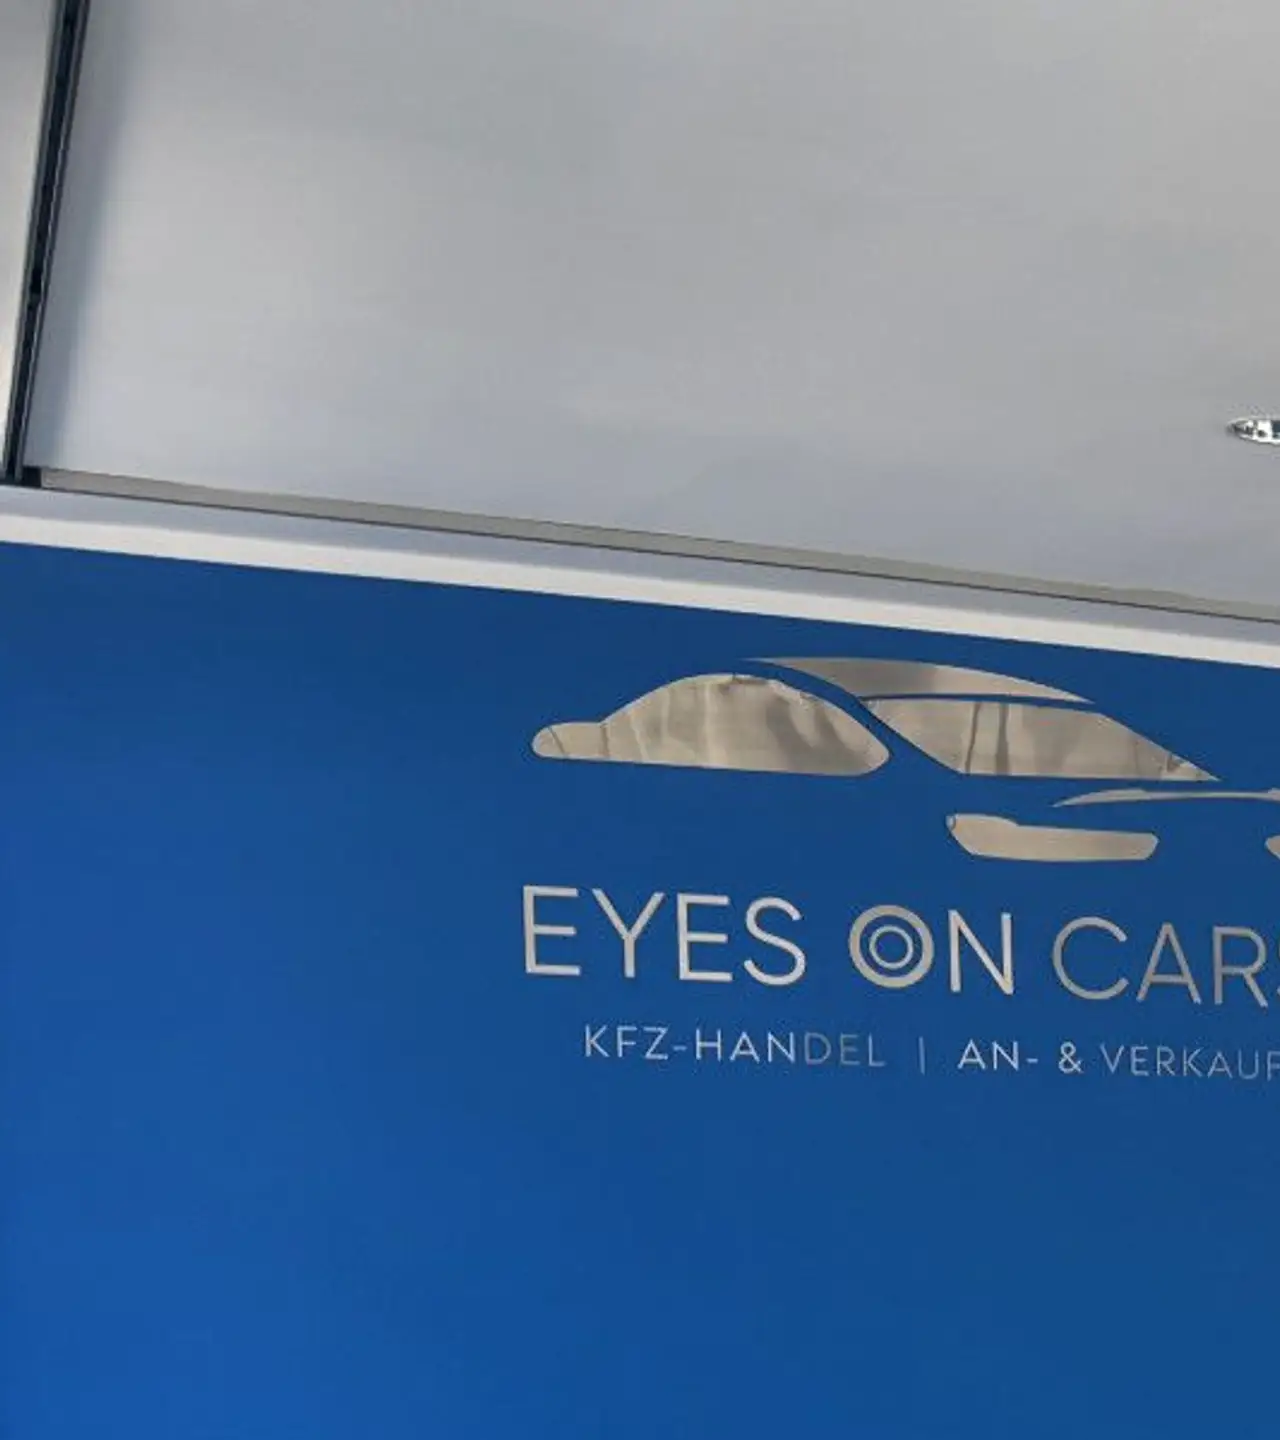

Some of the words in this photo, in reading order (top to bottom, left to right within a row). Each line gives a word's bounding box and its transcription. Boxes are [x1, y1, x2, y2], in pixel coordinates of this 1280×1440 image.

[522, 884, 807, 987] EYES
[848, 904, 1015, 995] ON
[584, 1023, 886, 1068] KFZ-HANDEL
[957, 1038, 1039, 1072] AN-
[1057, 1041, 1085, 1074] &
